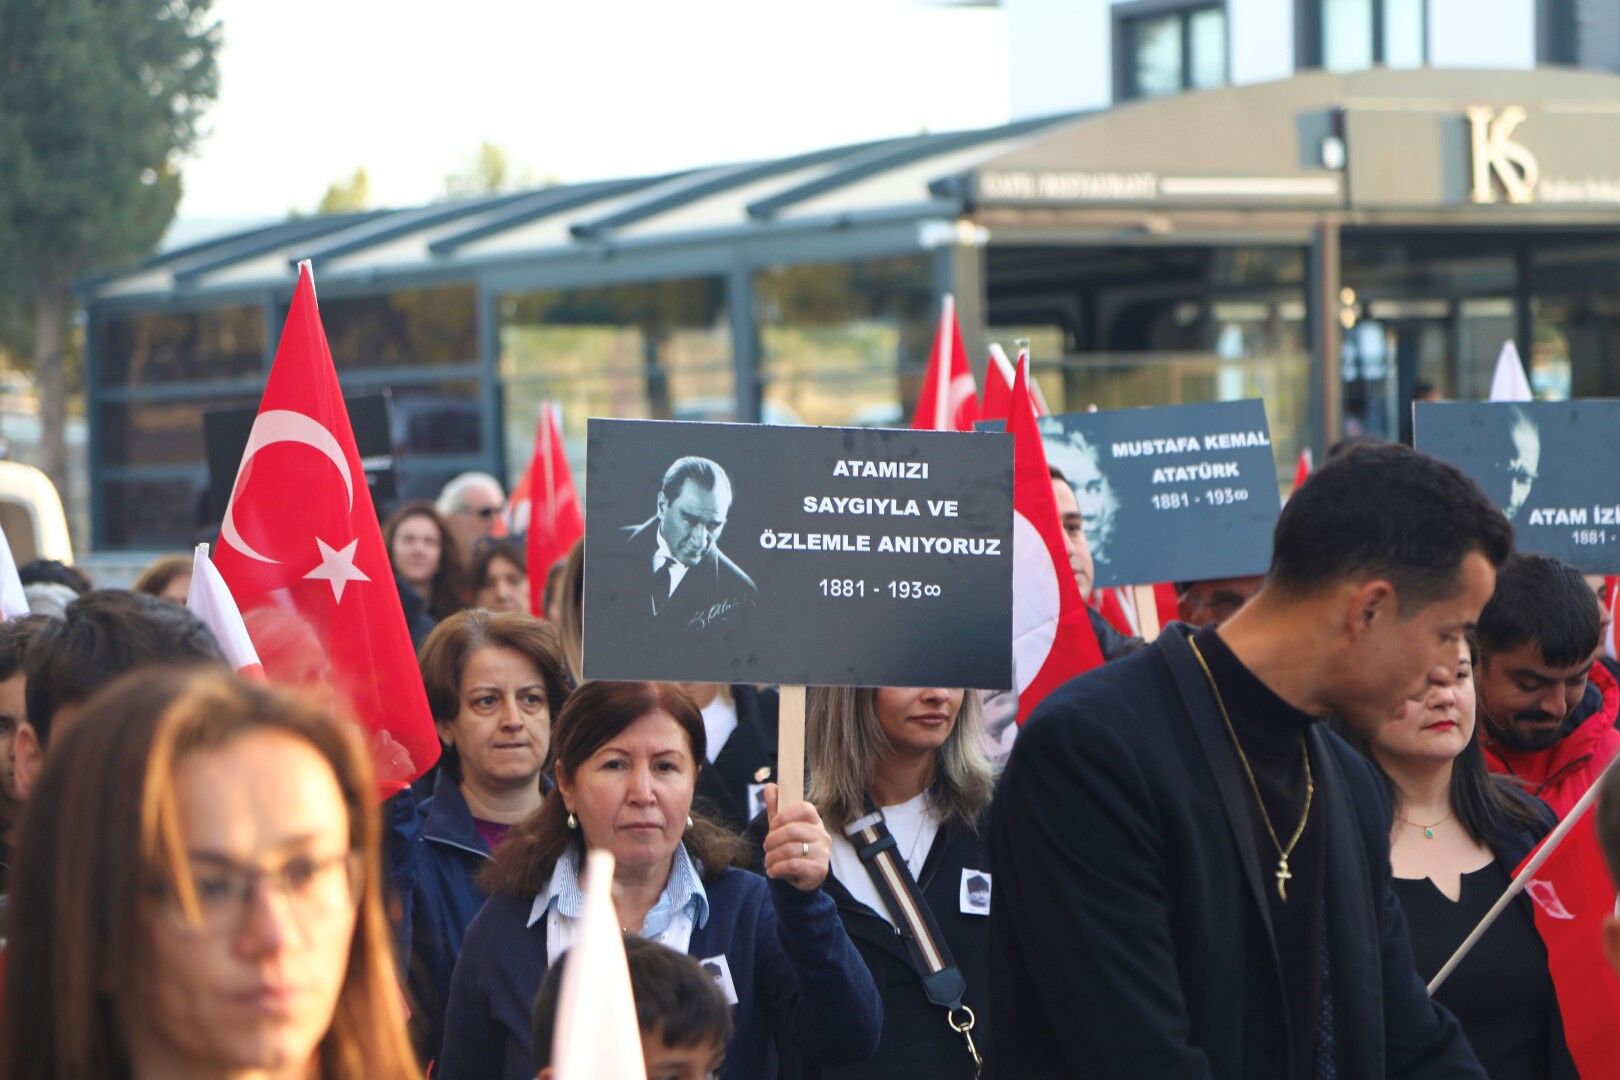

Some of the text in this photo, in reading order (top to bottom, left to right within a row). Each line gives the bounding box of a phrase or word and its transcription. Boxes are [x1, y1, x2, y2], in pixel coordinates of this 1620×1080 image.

[1111, 430, 1271, 458] MUSTAFA KEMAL
[832, 460, 930, 480] ATAMIZI
[1152, 461, 1240, 484] ATATÜRK
[803, 496, 959, 517] SAYGIYLA VE
[1152, 491, 1189, 510] 1881
[1529, 507, 1588, 525] ATAM
[759, 529, 1001, 556] ÖZLEMLE ANIYORUZ
[1572, 529, 1606, 545] 1881
[819, 579, 865, 598] 1881
